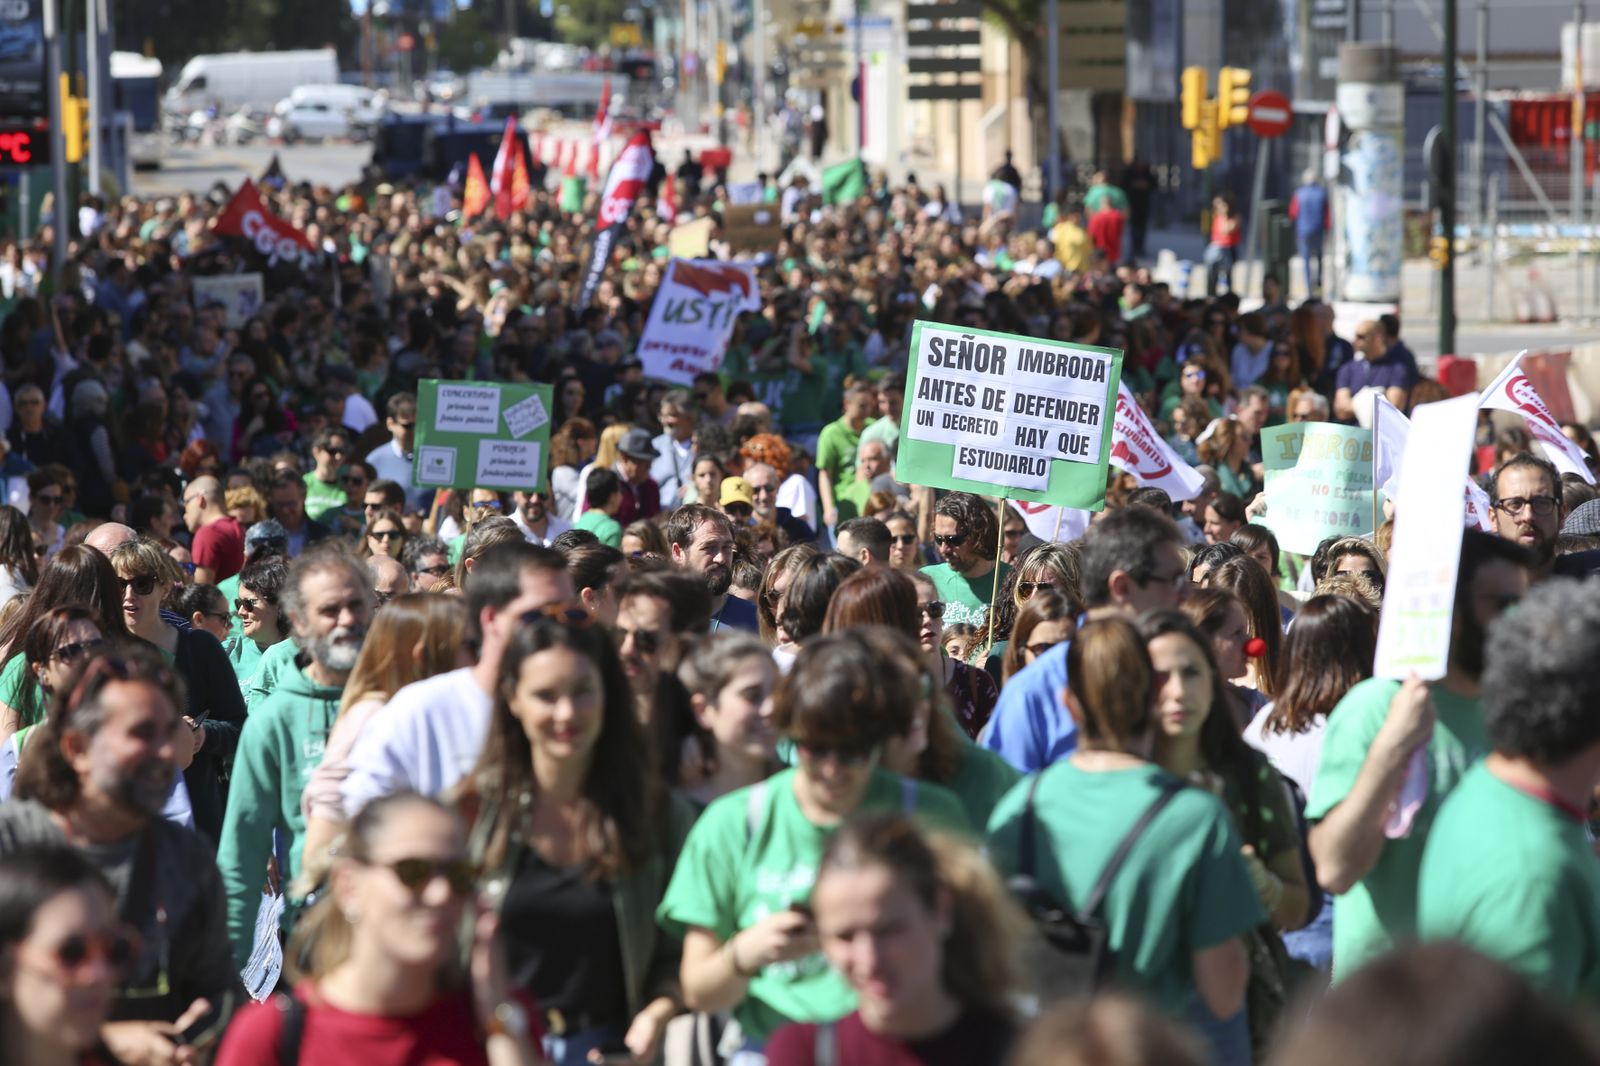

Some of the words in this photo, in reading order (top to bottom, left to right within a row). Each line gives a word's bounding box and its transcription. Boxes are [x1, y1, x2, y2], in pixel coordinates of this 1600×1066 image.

[927, 334, 1007, 375] SEÑOR
[1017, 347, 1106, 383] IMBRODA
[917, 377, 976, 408] ANTES
[981, 386, 1006, 413] DE
[1013, 393, 1100, 426] DEFENDER
[916, 409, 935, 427] UN
[941, 412, 999, 436] DECRETO
[1015, 426, 1048, 450] HAY
[1057, 432, 1090, 456] QUE
[1113, 421, 1166, 468] STUDIANTES
[958, 447, 1046, 477] ESTUDIARLO
[1311, 484, 1330, 497] NO
